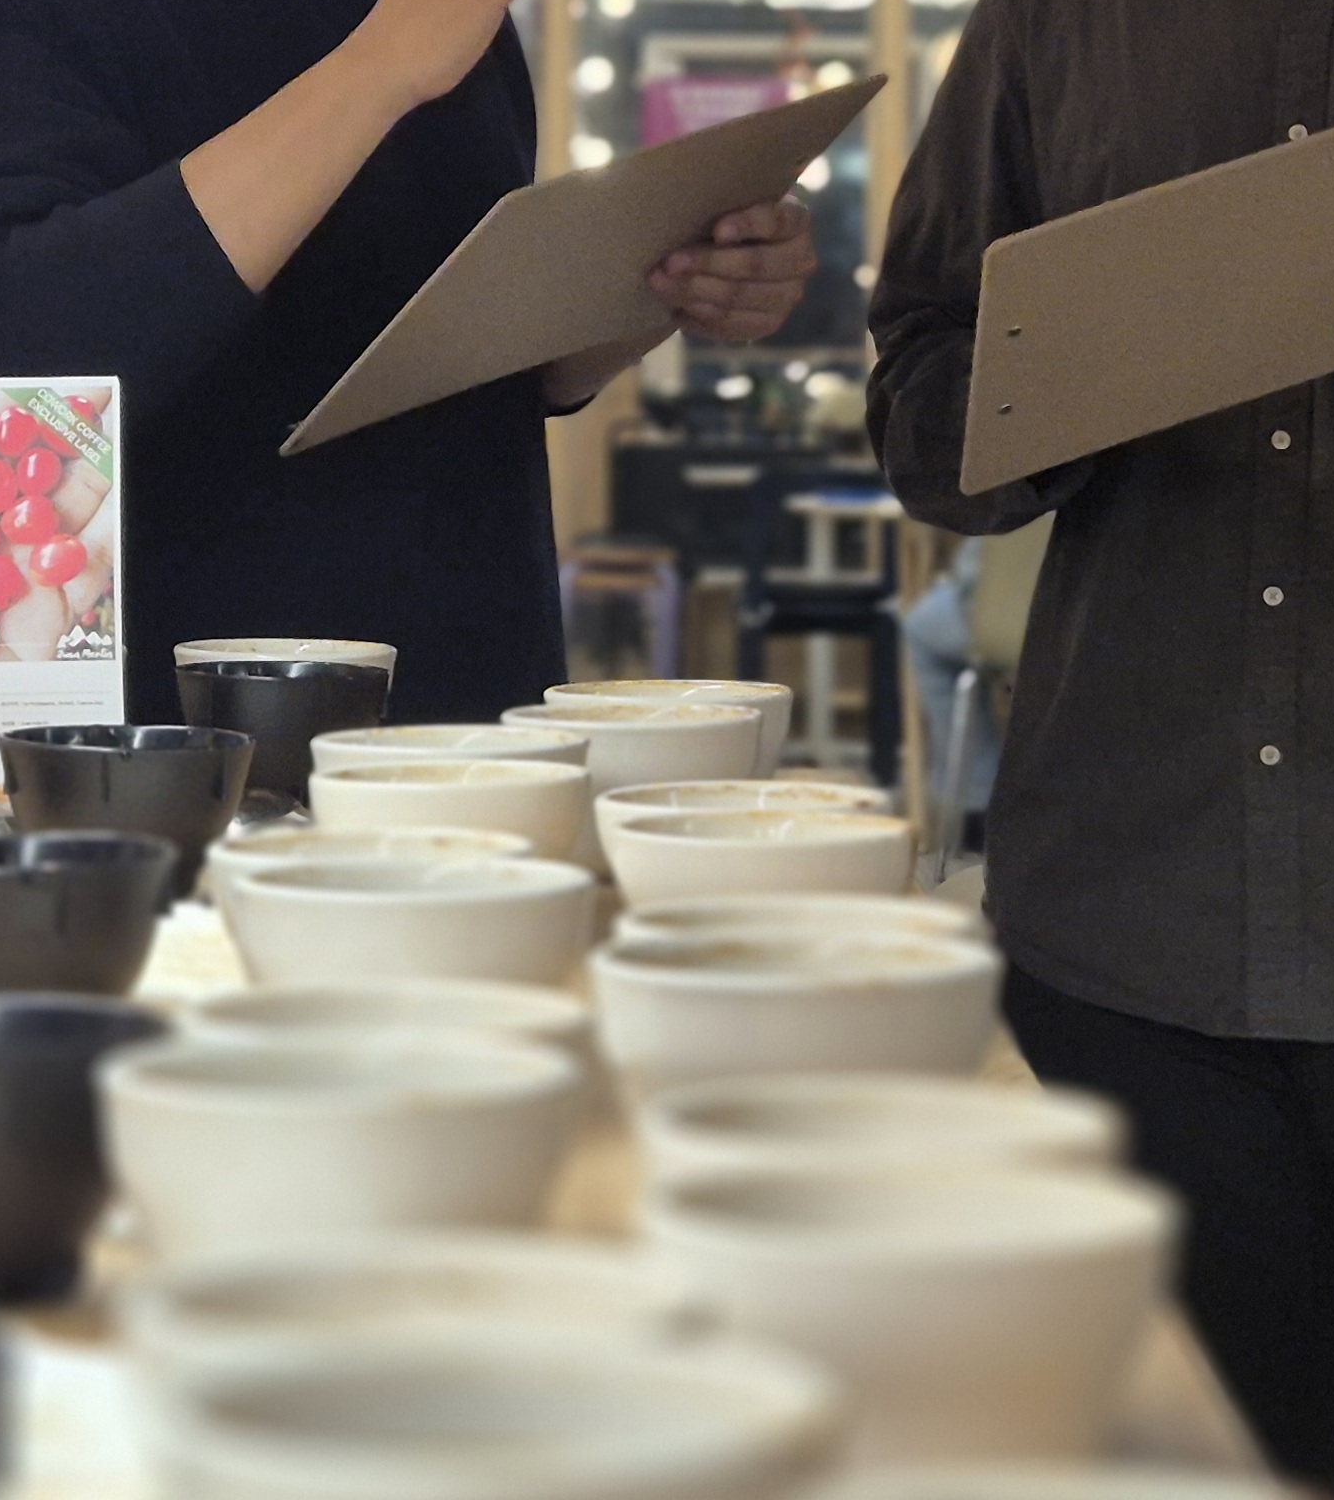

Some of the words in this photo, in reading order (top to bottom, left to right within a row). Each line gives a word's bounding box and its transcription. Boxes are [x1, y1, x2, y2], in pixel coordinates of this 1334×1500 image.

[28, 397, 77, 443] EXCLUSIVE
[37, 388, 79, 426] COWORK
[76, 421, 112, 454] COFFEE
